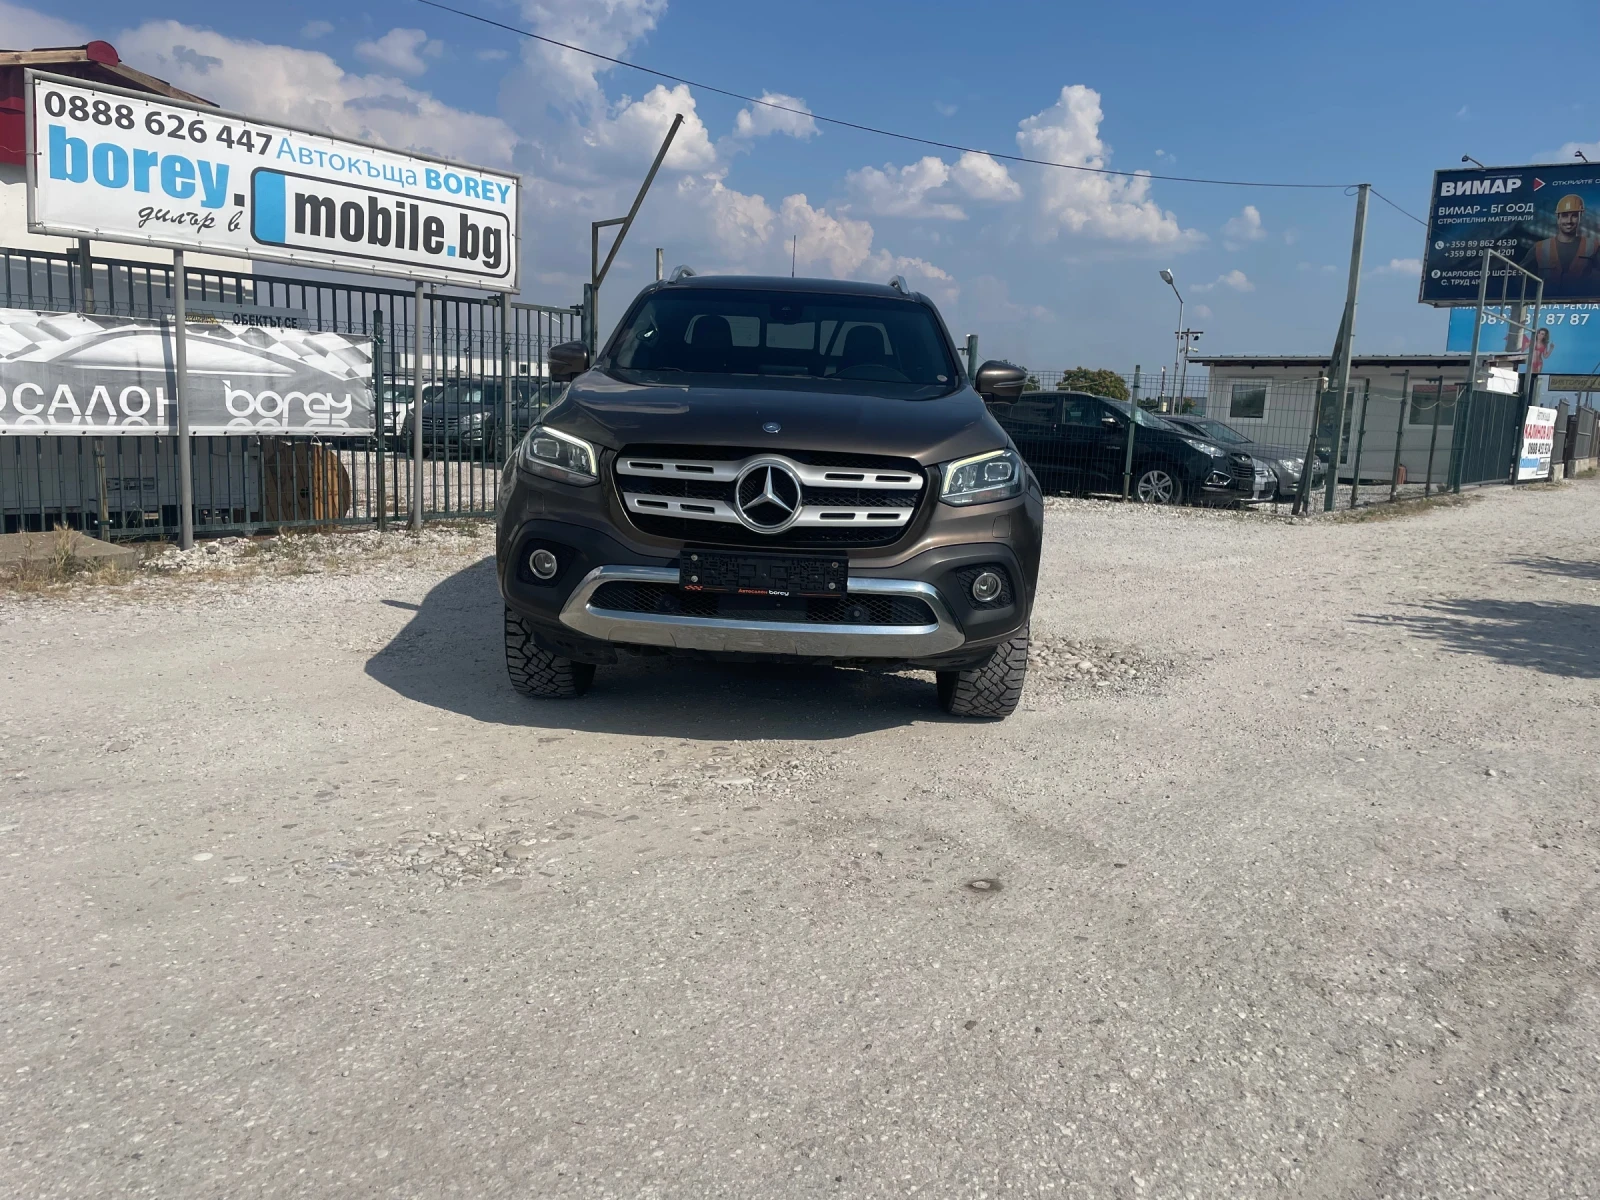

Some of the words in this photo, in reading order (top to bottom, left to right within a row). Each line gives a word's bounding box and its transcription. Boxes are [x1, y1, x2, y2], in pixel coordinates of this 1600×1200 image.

[44, 91, 135, 130] 0888
[144, 111, 207, 143] 626
[215, 125, 272, 155] 447
[425, 168, 510, 204] BOREY
[1440, 178, 1522, 196] ВИМАР
[138, 206, 216, 234] дилър
[1438, 205, 1480, 216] ВИМАР
[1490, 204, 1504, 213] БГ
[1506, 203, 1534, 213] ООД
[294, 192, 502, 270] mobile.bg
[233, 314, 281, 328] ОБЕКТЪТ
[284, 317, 297, 328] СЕ
[1545, 314, 1565, 325] 87
[1570, 314, 1590, 325] 87
[0, 382, 178, 417] САЛОН
[222, 380, 352, 418] borey
